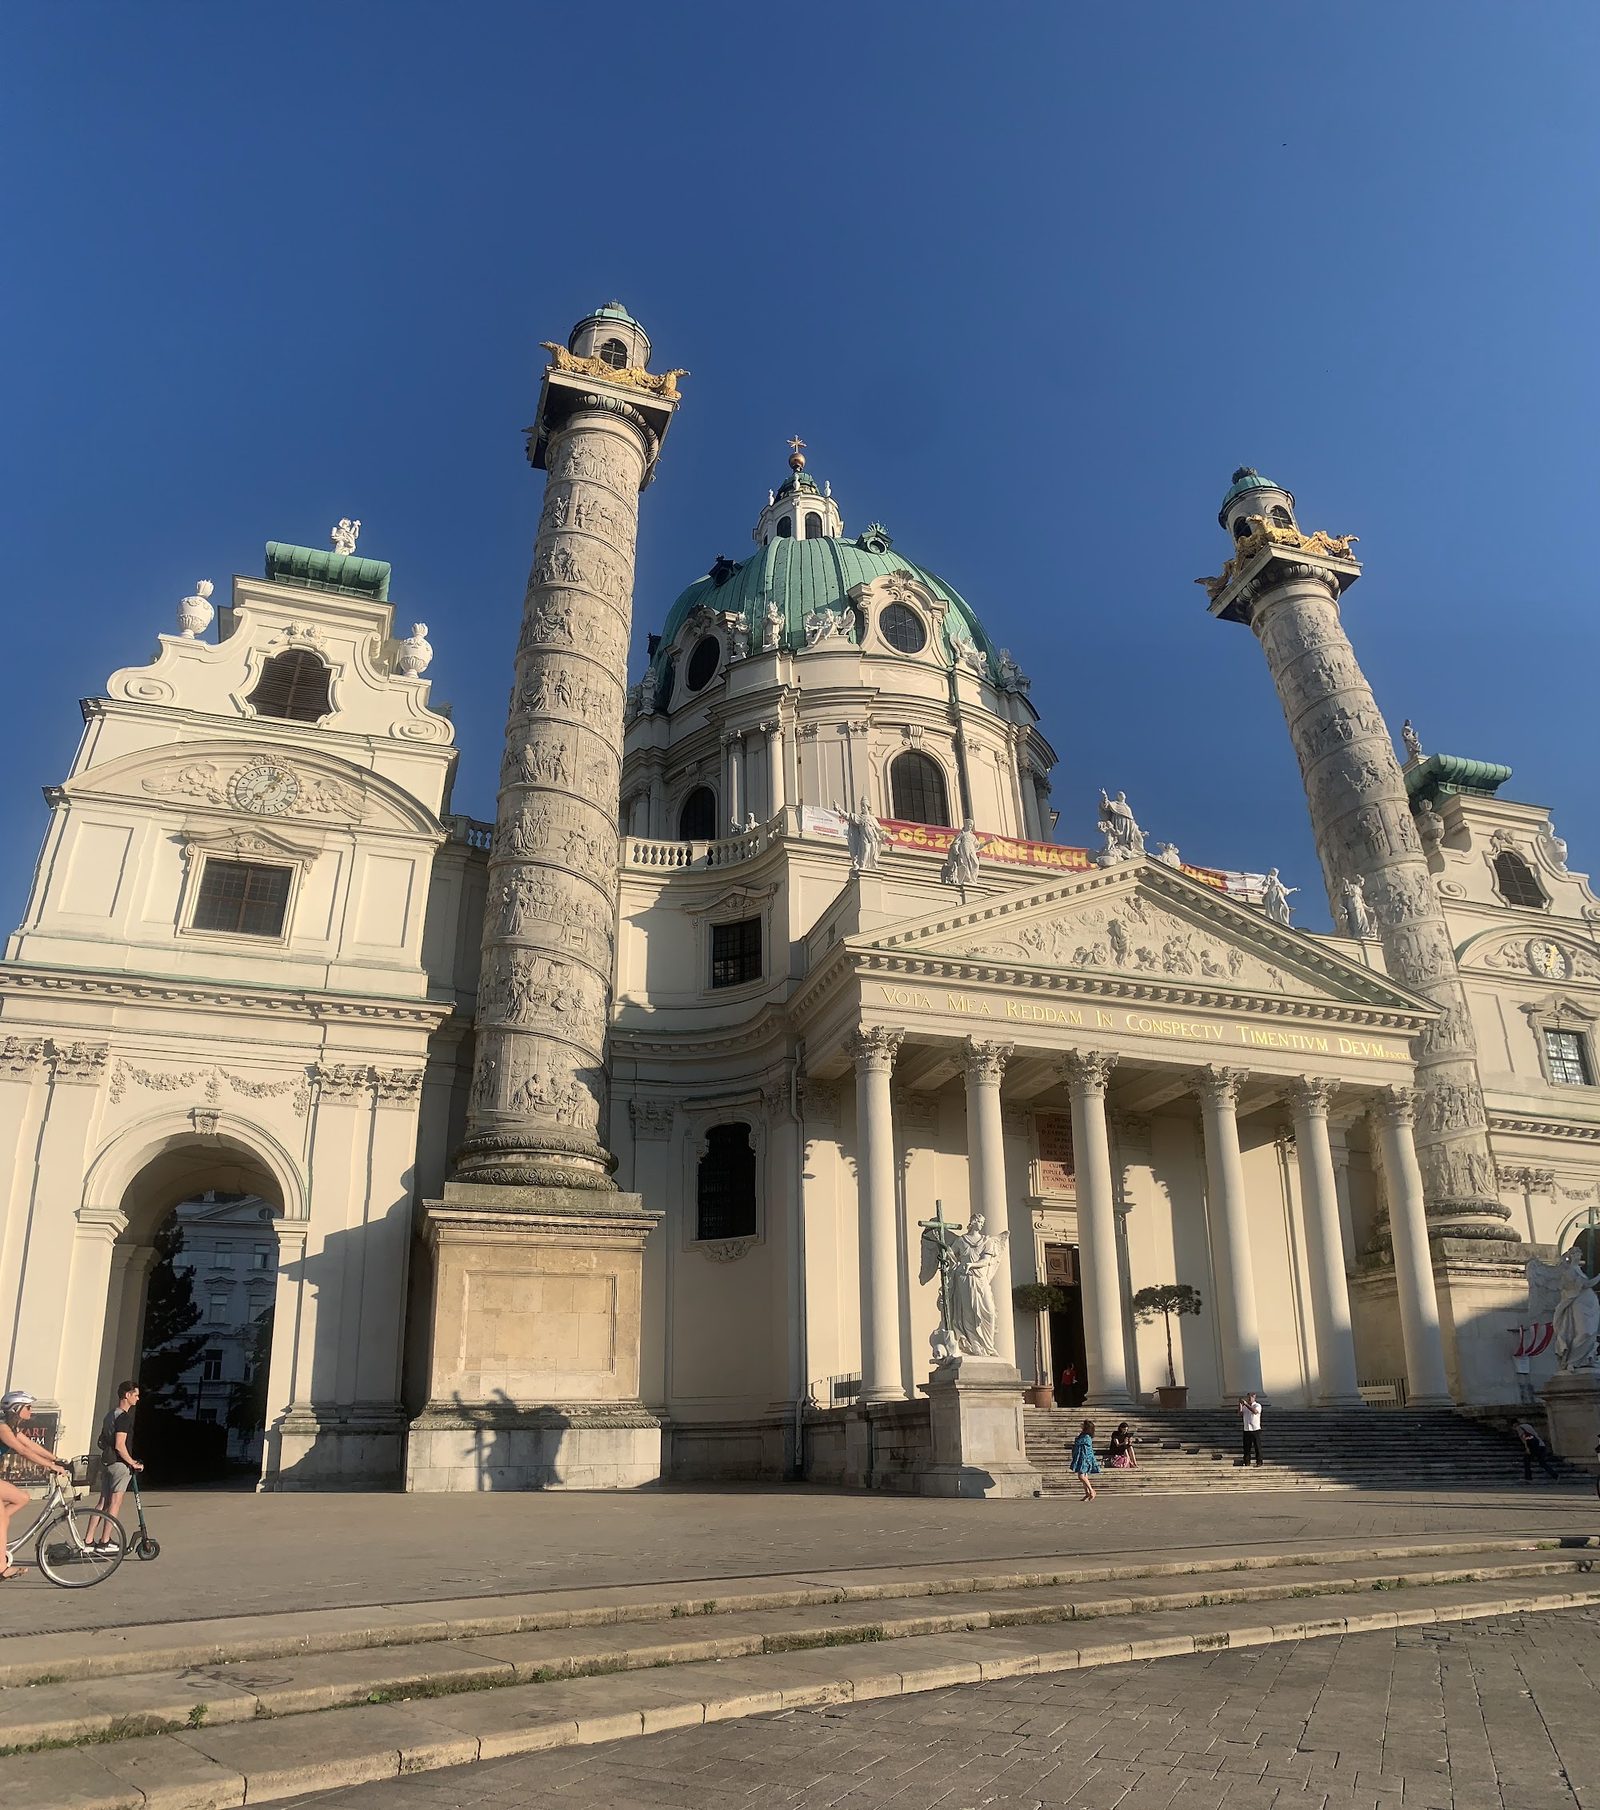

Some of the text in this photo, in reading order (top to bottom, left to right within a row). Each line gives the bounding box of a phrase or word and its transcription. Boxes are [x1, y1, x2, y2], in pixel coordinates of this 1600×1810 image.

[1033, 844, 1098, 869] NACH
[880, 985, 933, 1009] VOTA
[947, 993, 991, 1015] MEA
[1005, 1000, 1083, 1025] REDDAM
[1095, 1009, 1113, 1028] IN
[1126, 1014, 1224, 1039] CONSPECTV
[1236, 1025, 1329, 1052] TIMENTIVM
[1339, 1038, 1385, 1057] DEVM
